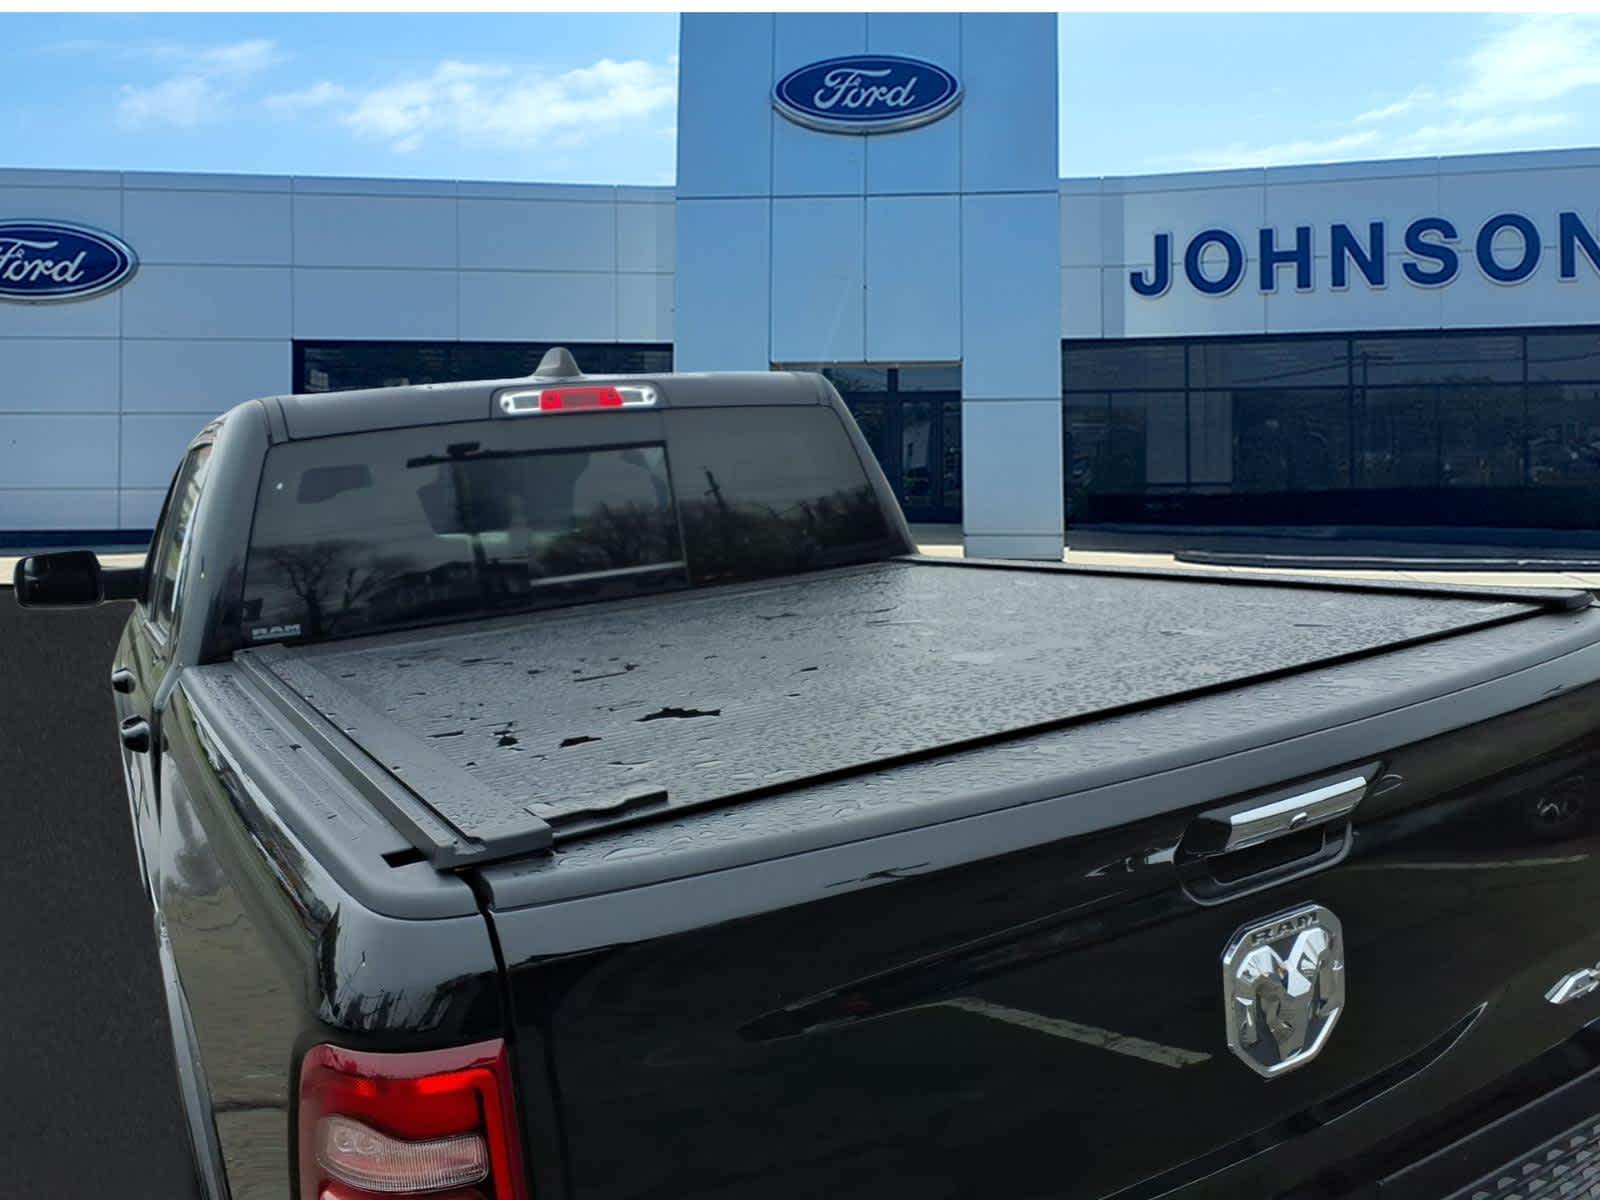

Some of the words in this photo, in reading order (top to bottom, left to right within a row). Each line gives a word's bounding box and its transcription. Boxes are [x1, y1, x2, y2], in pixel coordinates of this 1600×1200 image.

[814, 68, 917, 109] Ford
[1129, 211, 1600, 296] JOHNSON
[251, 624, 301, 640] RAM
[1251, 911, 1320, 946] RAM
